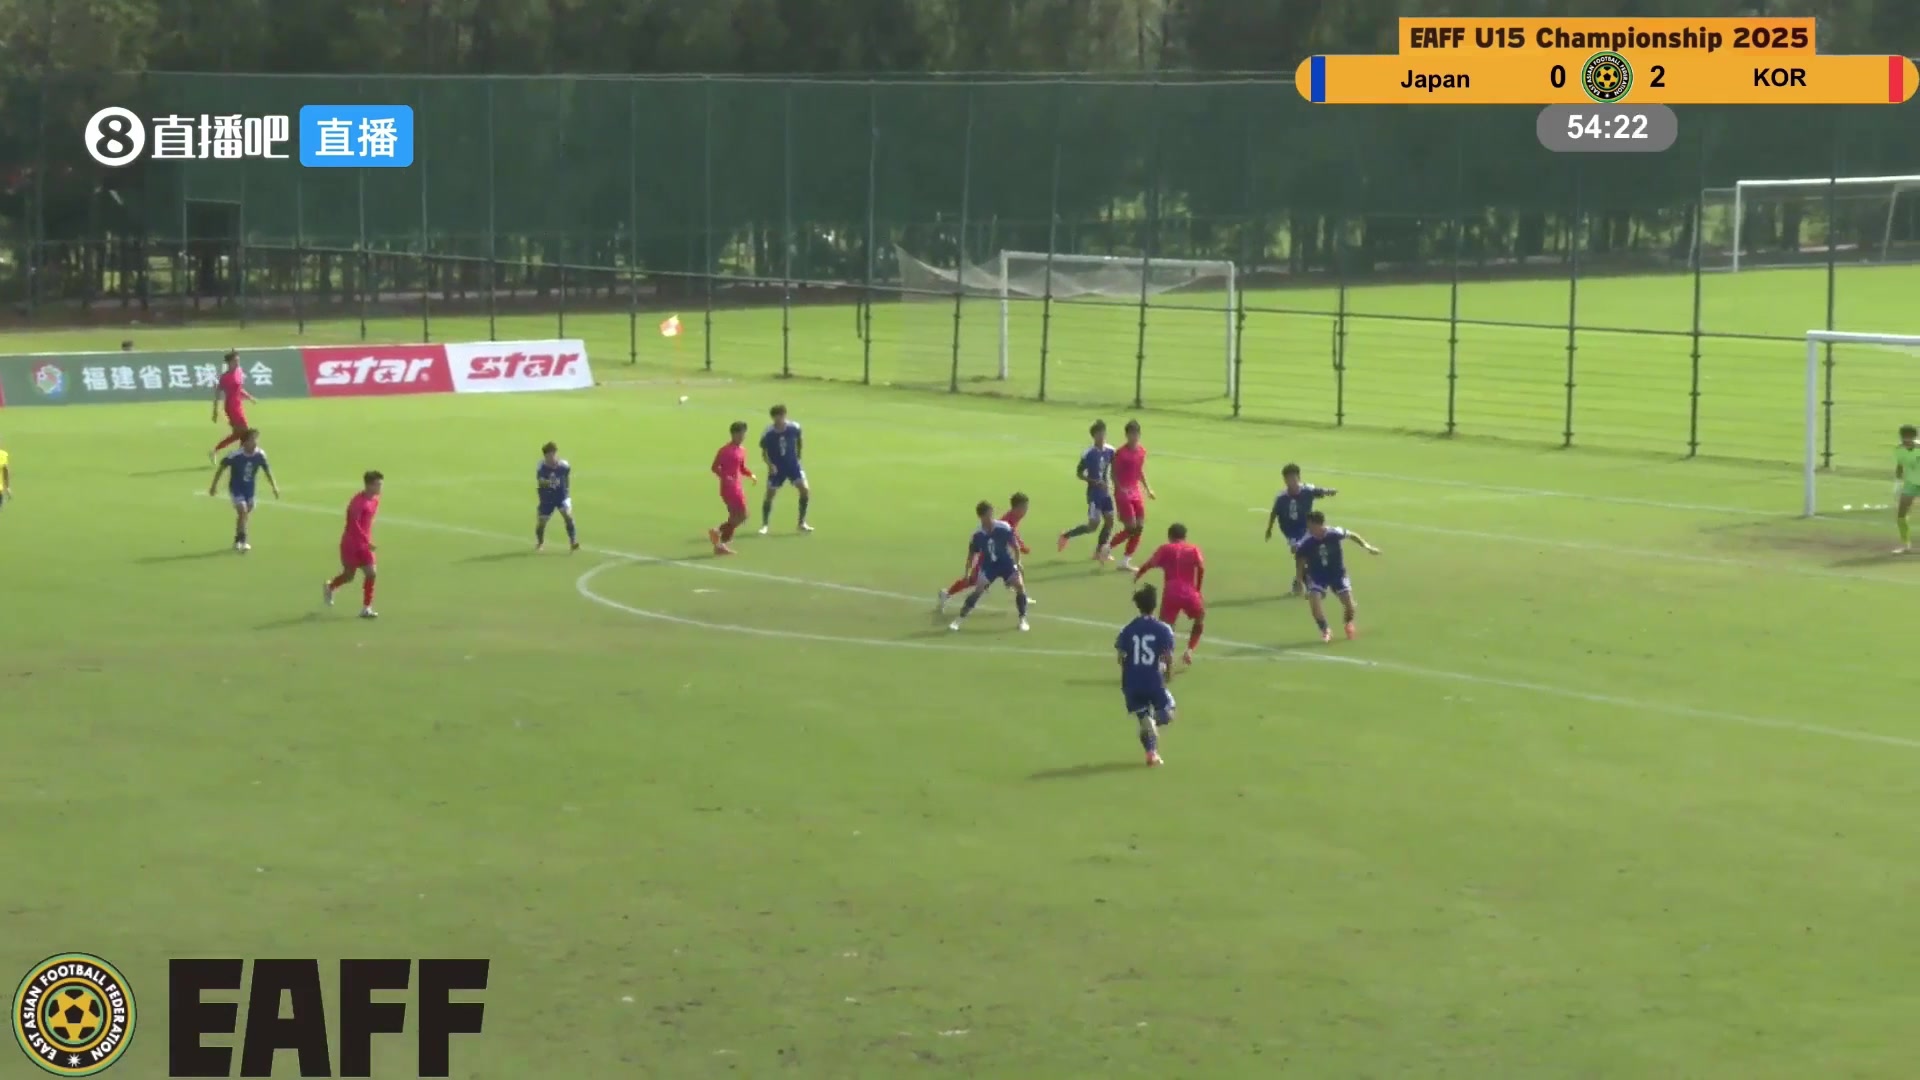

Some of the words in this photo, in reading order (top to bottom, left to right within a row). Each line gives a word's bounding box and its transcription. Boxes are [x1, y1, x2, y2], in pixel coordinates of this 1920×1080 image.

[82, 361, 273, 391] 福建省足球会
[1132, 634, 1156, 665] 15
